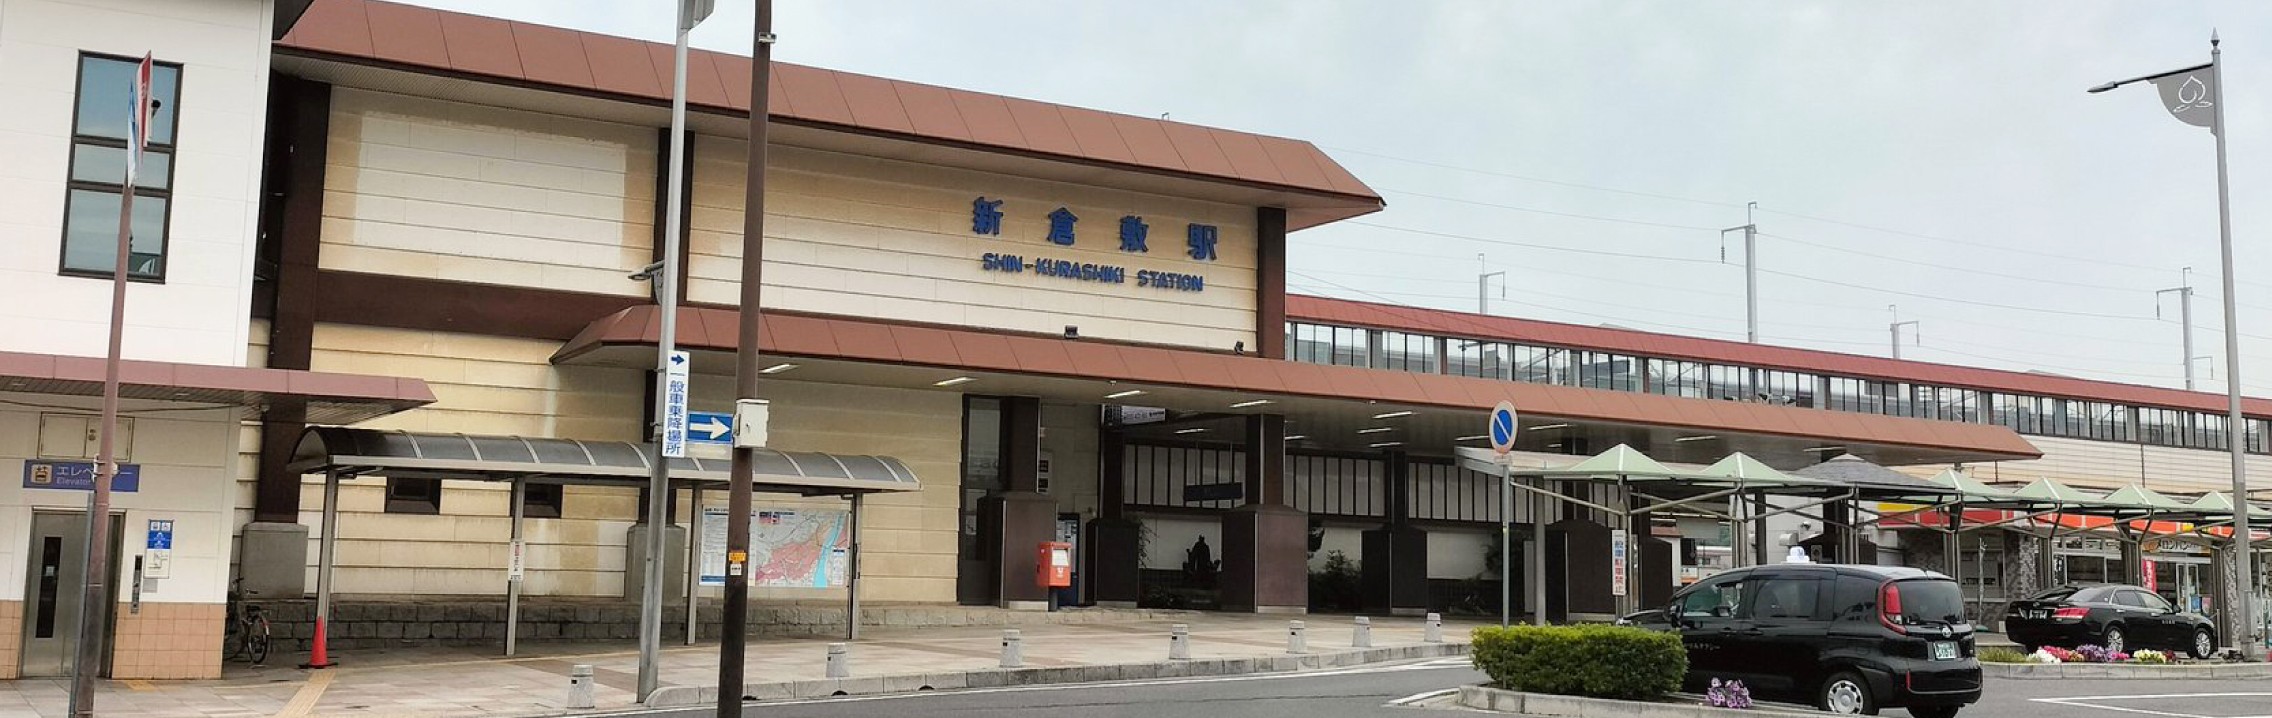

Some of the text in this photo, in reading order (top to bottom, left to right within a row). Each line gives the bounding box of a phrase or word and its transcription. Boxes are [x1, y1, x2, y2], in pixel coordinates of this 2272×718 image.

[973, 196, 1217, 260] 新倉敷駅
[983, 252, 1203, 292] SHIN-KURASHIKI STATION
[665, 372, 685, 456] 一般車乗降場所
